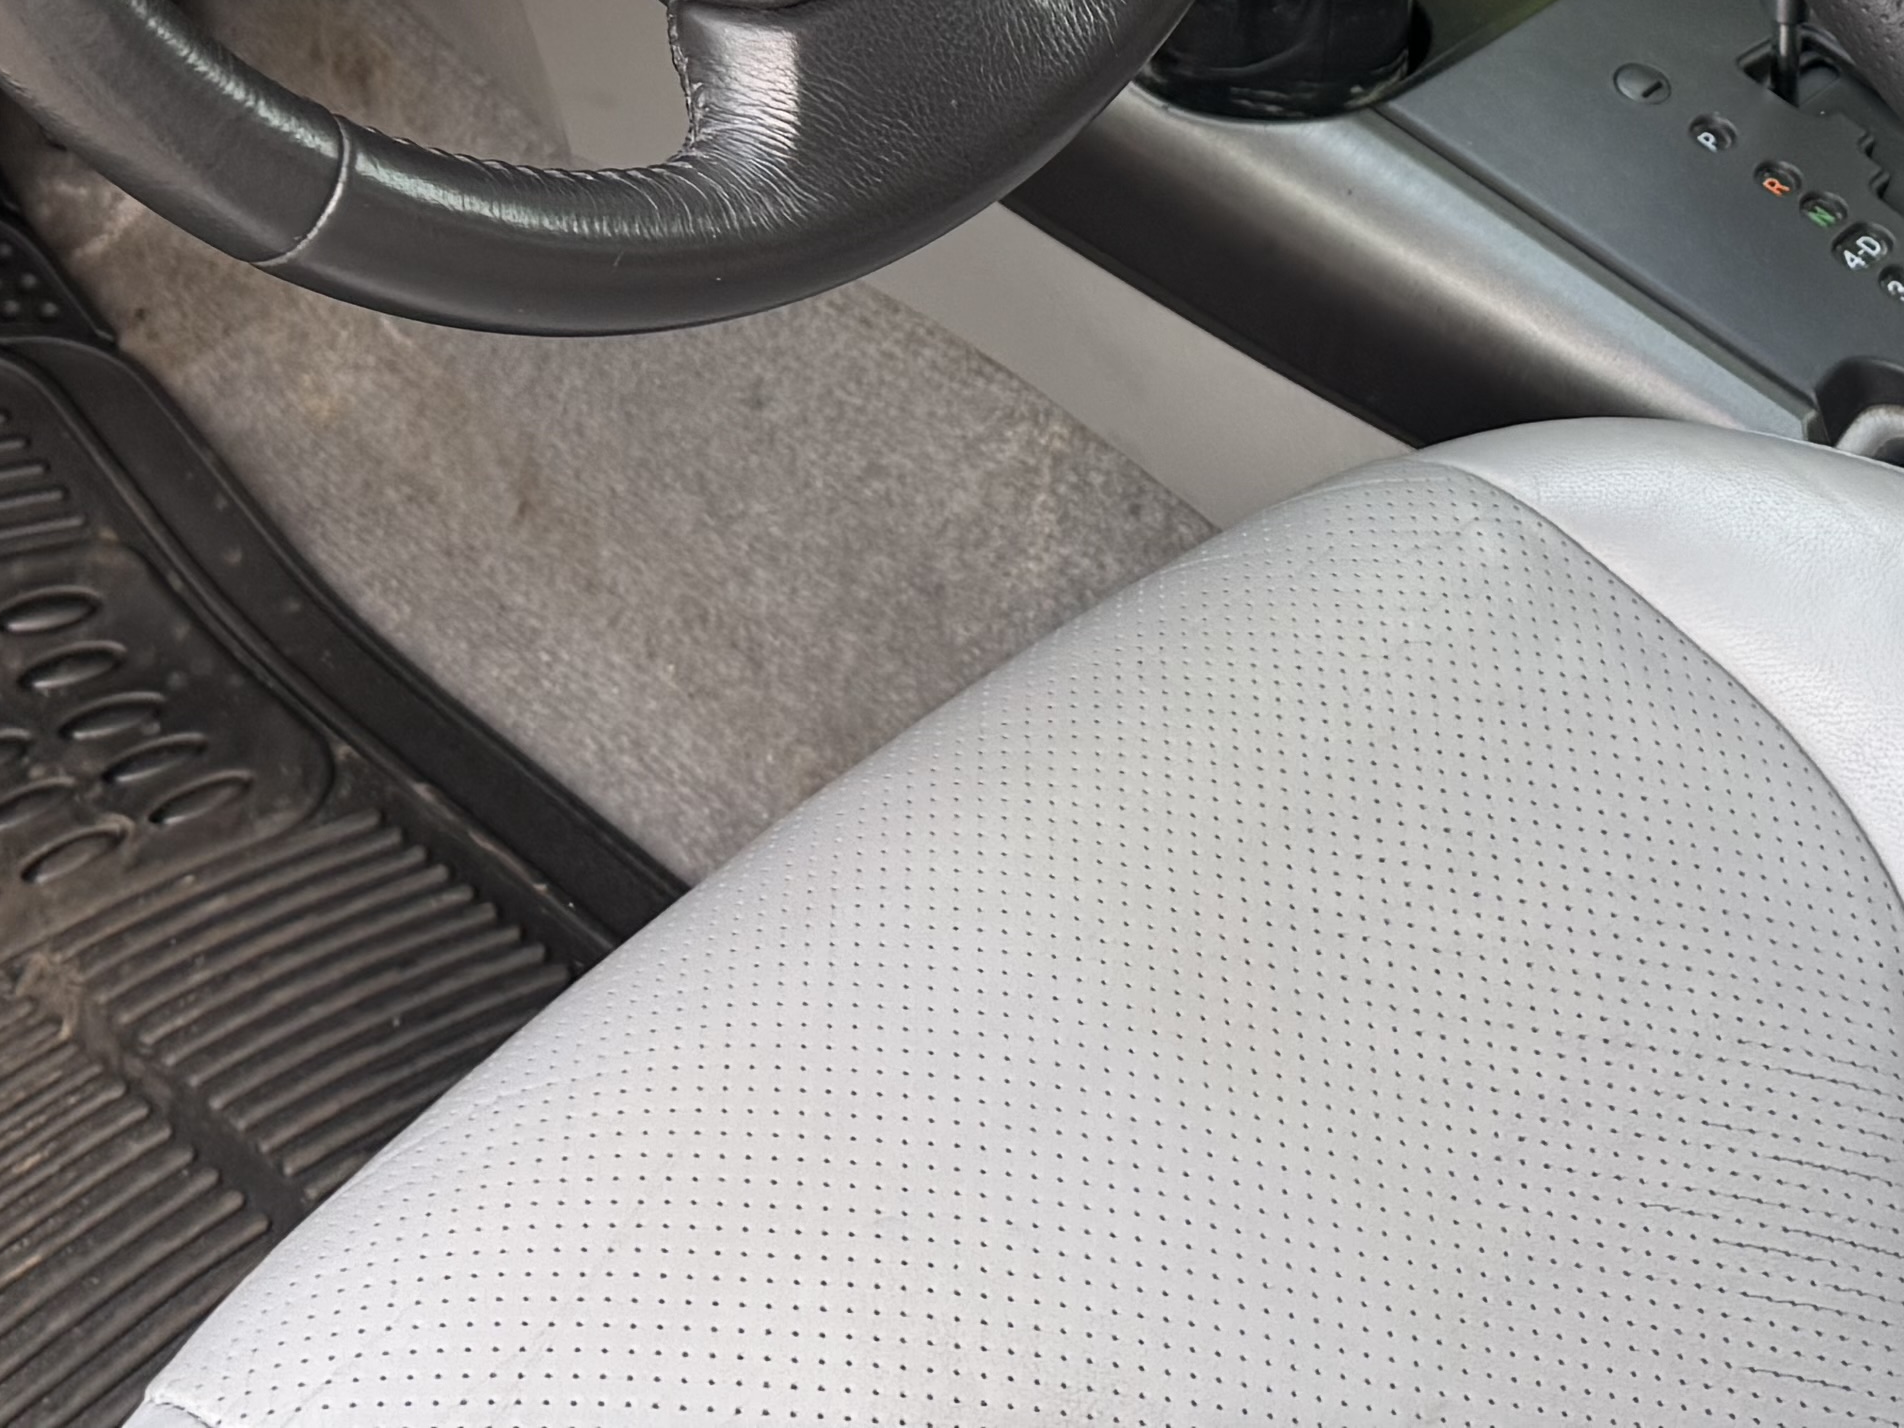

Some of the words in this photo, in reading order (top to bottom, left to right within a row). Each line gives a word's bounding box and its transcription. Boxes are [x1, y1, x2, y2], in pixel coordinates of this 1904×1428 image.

[1697, 131, 1718, 153] P
[1762, 177, 1790, 197] R
[1808, 206, 1836, 227] N
[1844, 235, 1882, 271] 4-D
